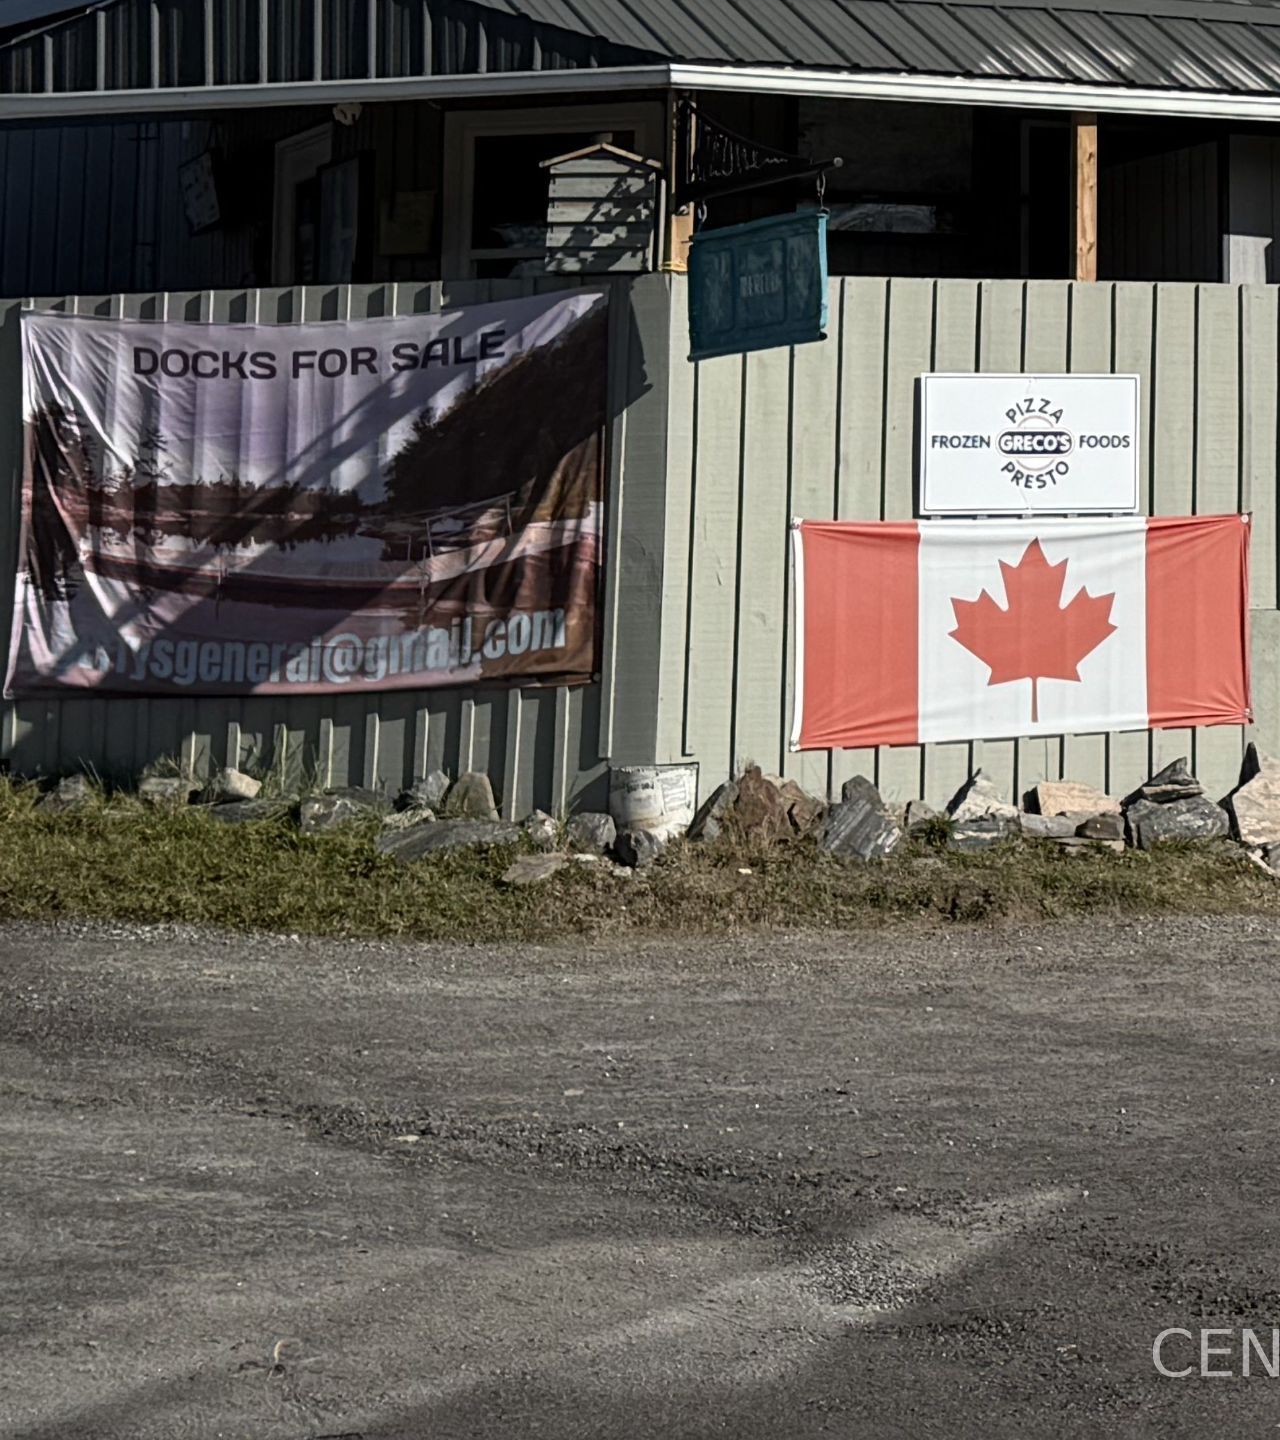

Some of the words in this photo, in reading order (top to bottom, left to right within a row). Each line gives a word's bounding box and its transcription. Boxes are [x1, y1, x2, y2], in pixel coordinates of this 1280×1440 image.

[132, 346, 278, 380] DOCKS
[291, 346, 378, 377] FOR
[391, 330, 506, 373] SALE
[1005, 397, 1064, 424] PIZZA
[931, 435, 991, 449] FROZEN
[999, 434, 1072, 452] GRECO'S
[1078, 435, 1130, 449] FOODS
[1001, 460, 1070, 489] PRESTO
